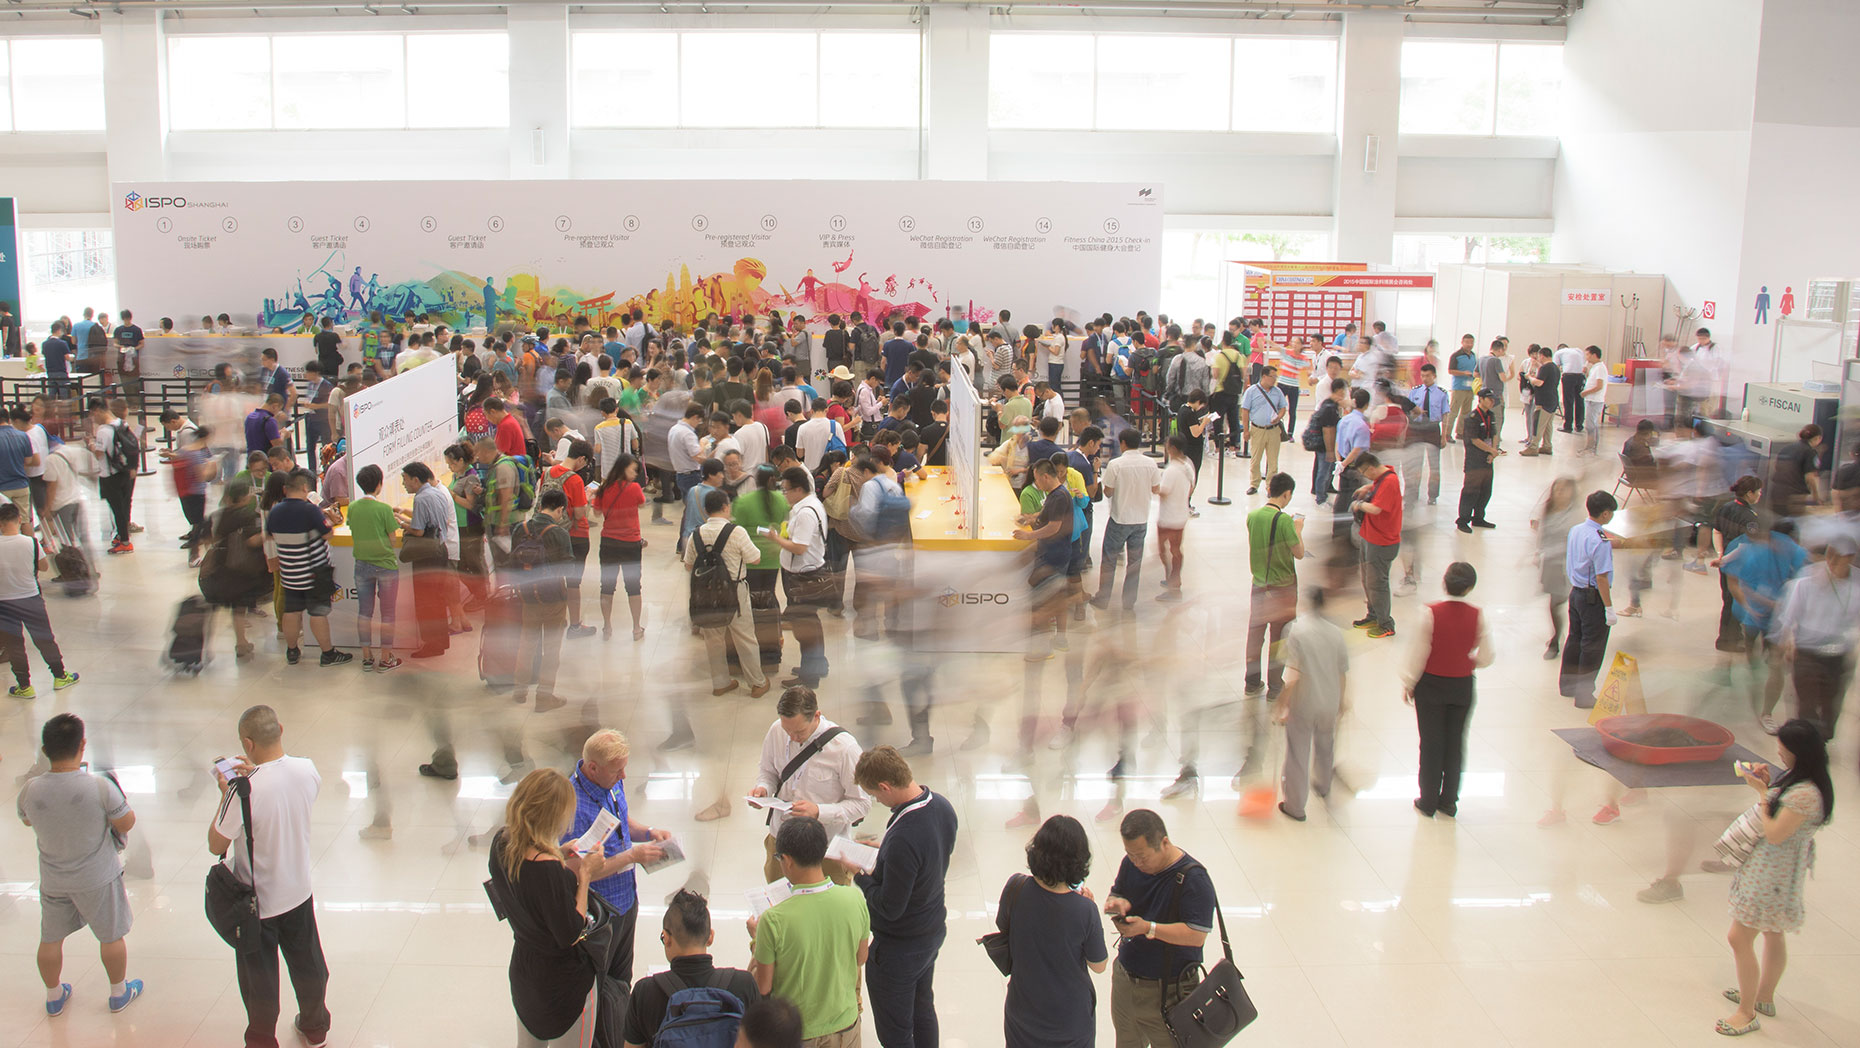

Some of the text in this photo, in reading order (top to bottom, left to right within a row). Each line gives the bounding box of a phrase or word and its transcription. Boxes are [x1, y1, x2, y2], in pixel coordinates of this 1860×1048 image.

[144, 197, 187, 208] ISPO
[564, 234, 608, 242] Pre-registered
[704, 234, 750, 242] Pre-registered
[934, 235, 974, 243] Registration
[1769, 397, 1801, 413] FISCAN
[961, 593, 1010, 605] ISPO
